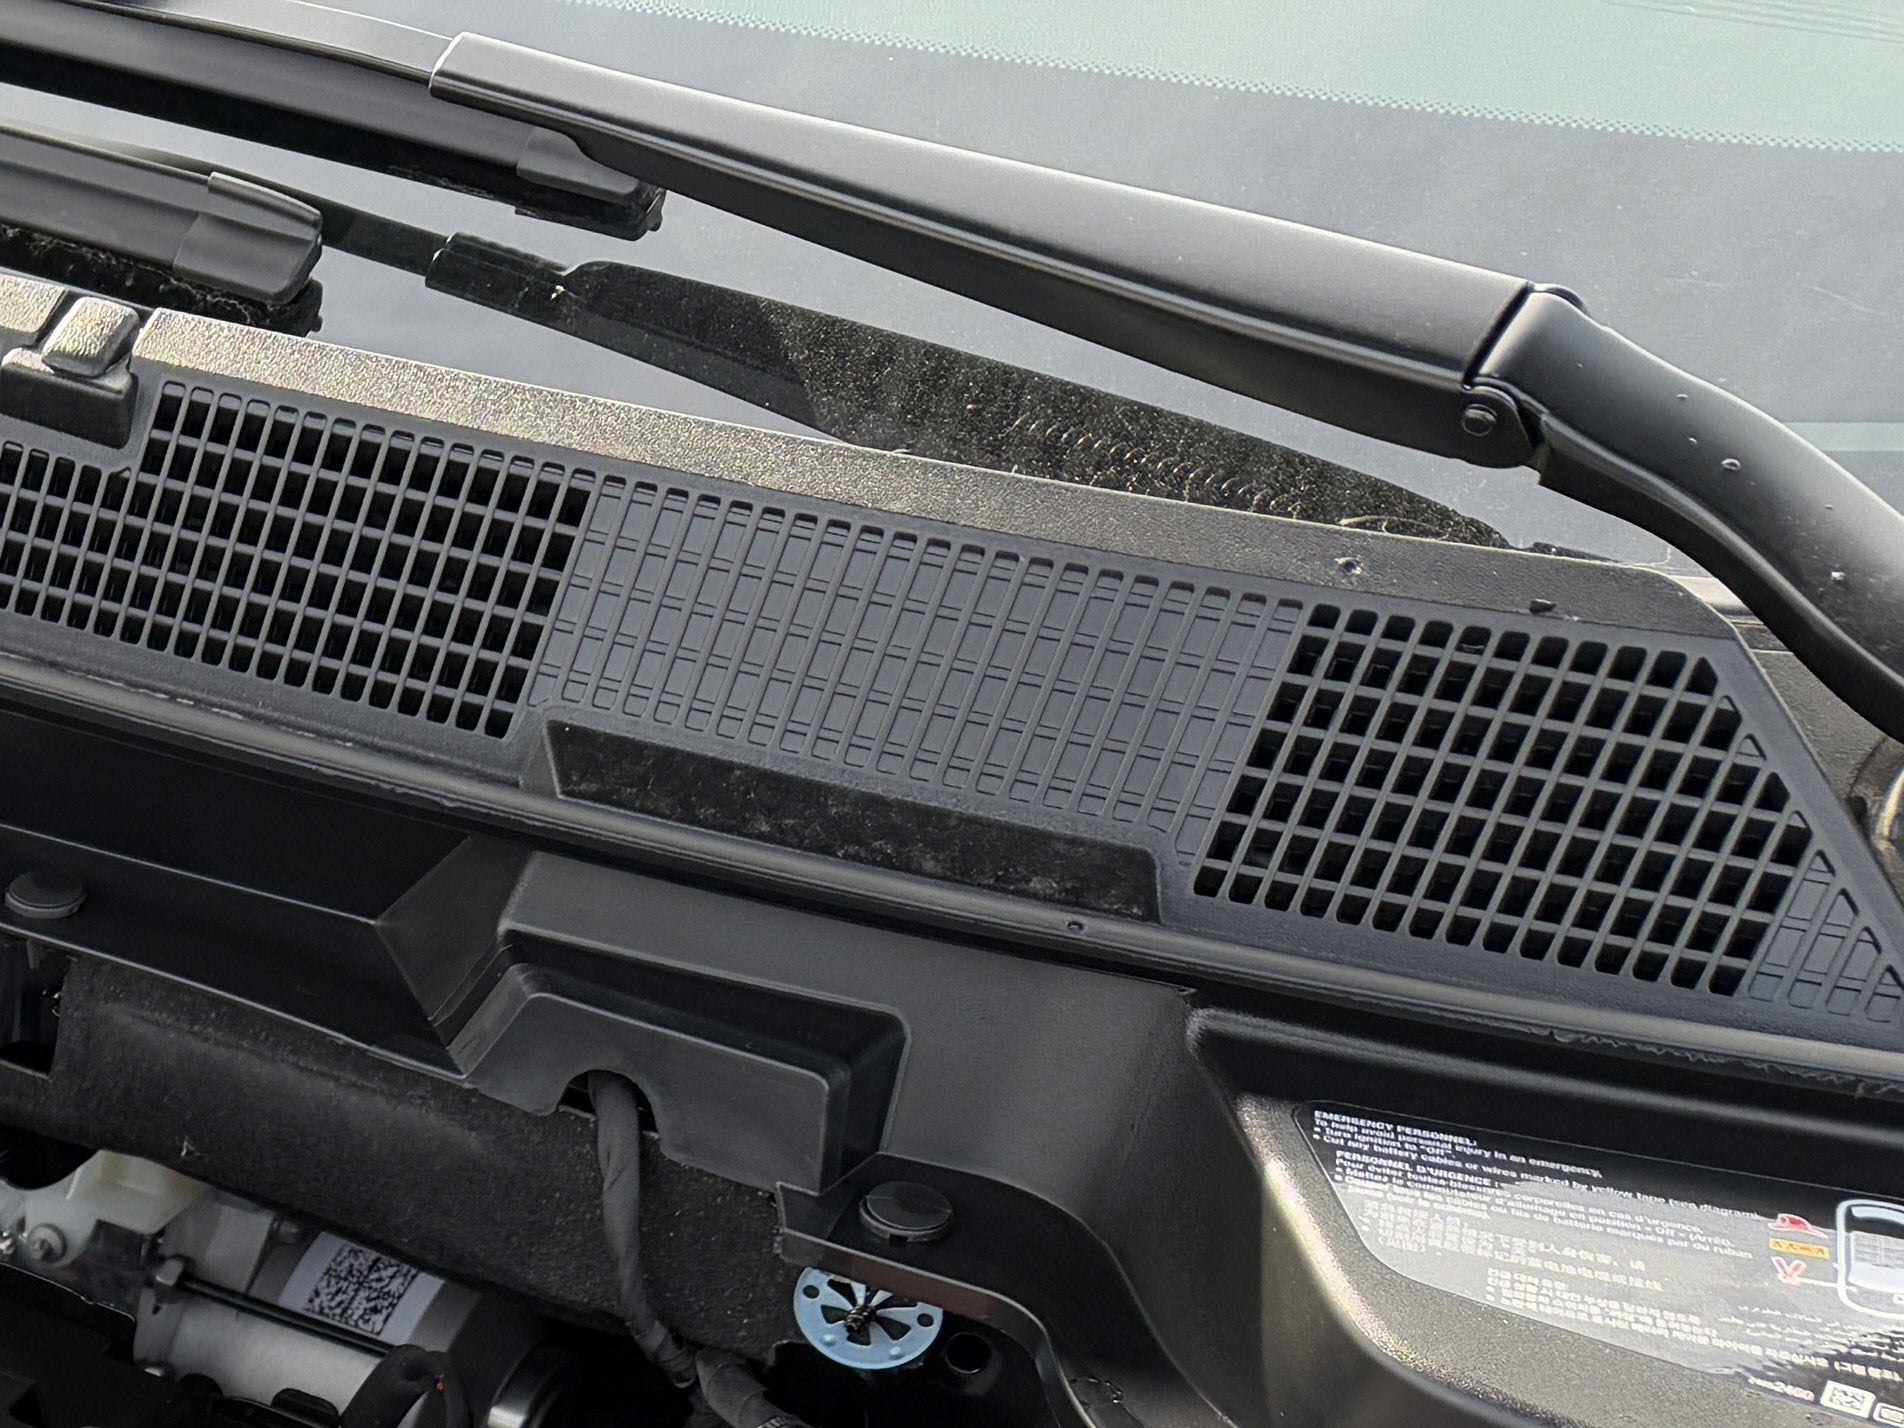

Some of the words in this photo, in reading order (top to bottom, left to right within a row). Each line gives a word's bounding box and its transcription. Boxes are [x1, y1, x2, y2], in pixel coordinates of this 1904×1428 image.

[1314, 1110, 1393, 1131] EMERGENCY
[1354, 1134, 1401, 1148] ignition
[1398, 1134, 1451, 1150] personal
[1455, 1144, 1490, 1158] injury
[1373, 1145, 1417, 1159] battery
[1421, 1154, 1461, 1166] cables
[1481, 1165, 1516, 1176] wires
